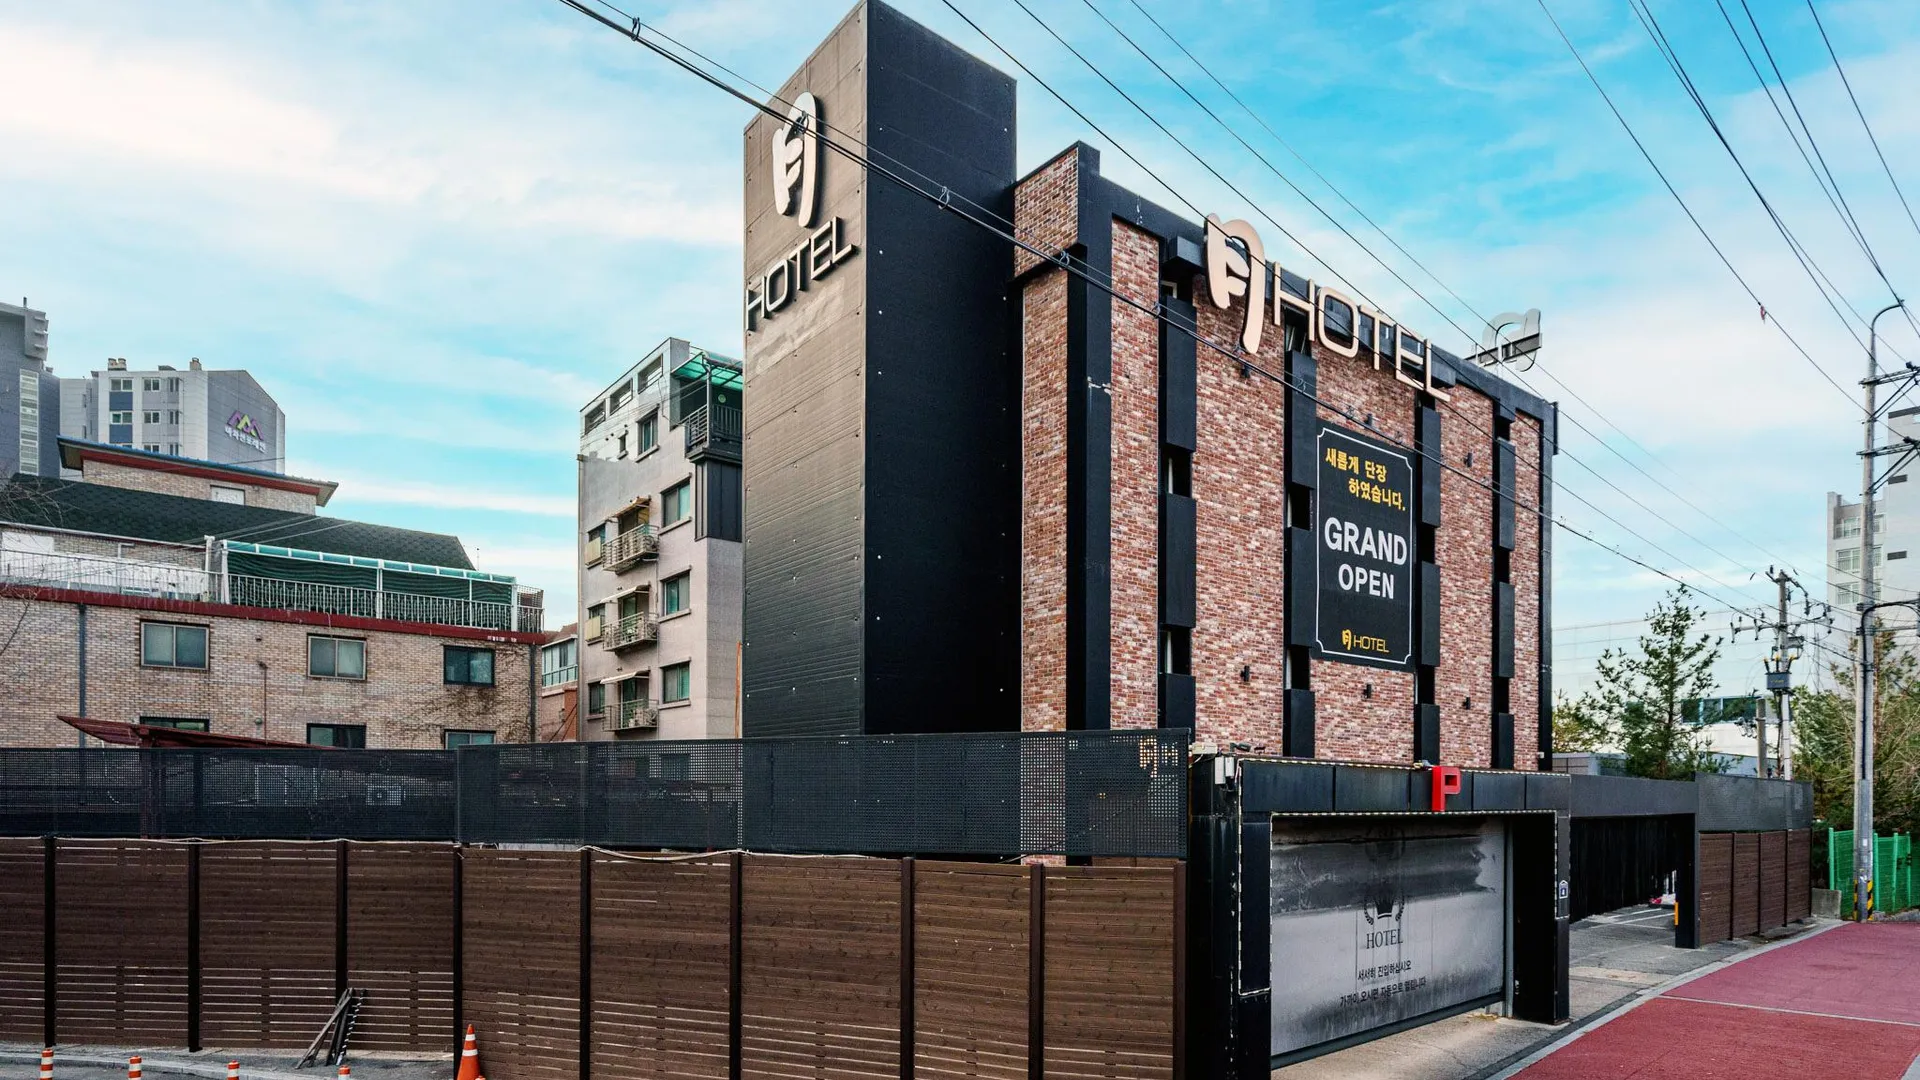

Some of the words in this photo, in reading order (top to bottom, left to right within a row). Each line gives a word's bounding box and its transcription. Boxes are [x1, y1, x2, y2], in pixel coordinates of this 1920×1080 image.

[746, 217, 856, 331] HOTEL
[1273, 261, 1451, 402] HOTEL
[1325, 448, 1359, 475] 새롭게
[1364, 460, 1387, 483] 단장
[1348, 478, 1406, 511] 하였습니다.
[1324, 517, 1408, 566] GRAND
[1338, 564, 1395, 599] OPEN
[1353, 635, 1390, 653] HOTEL
[1431, 766, 1461, 812] P
[1366, 929, 1403, 949] HOTEL
[1377, 960, 1412, 978] 진입하십시오
